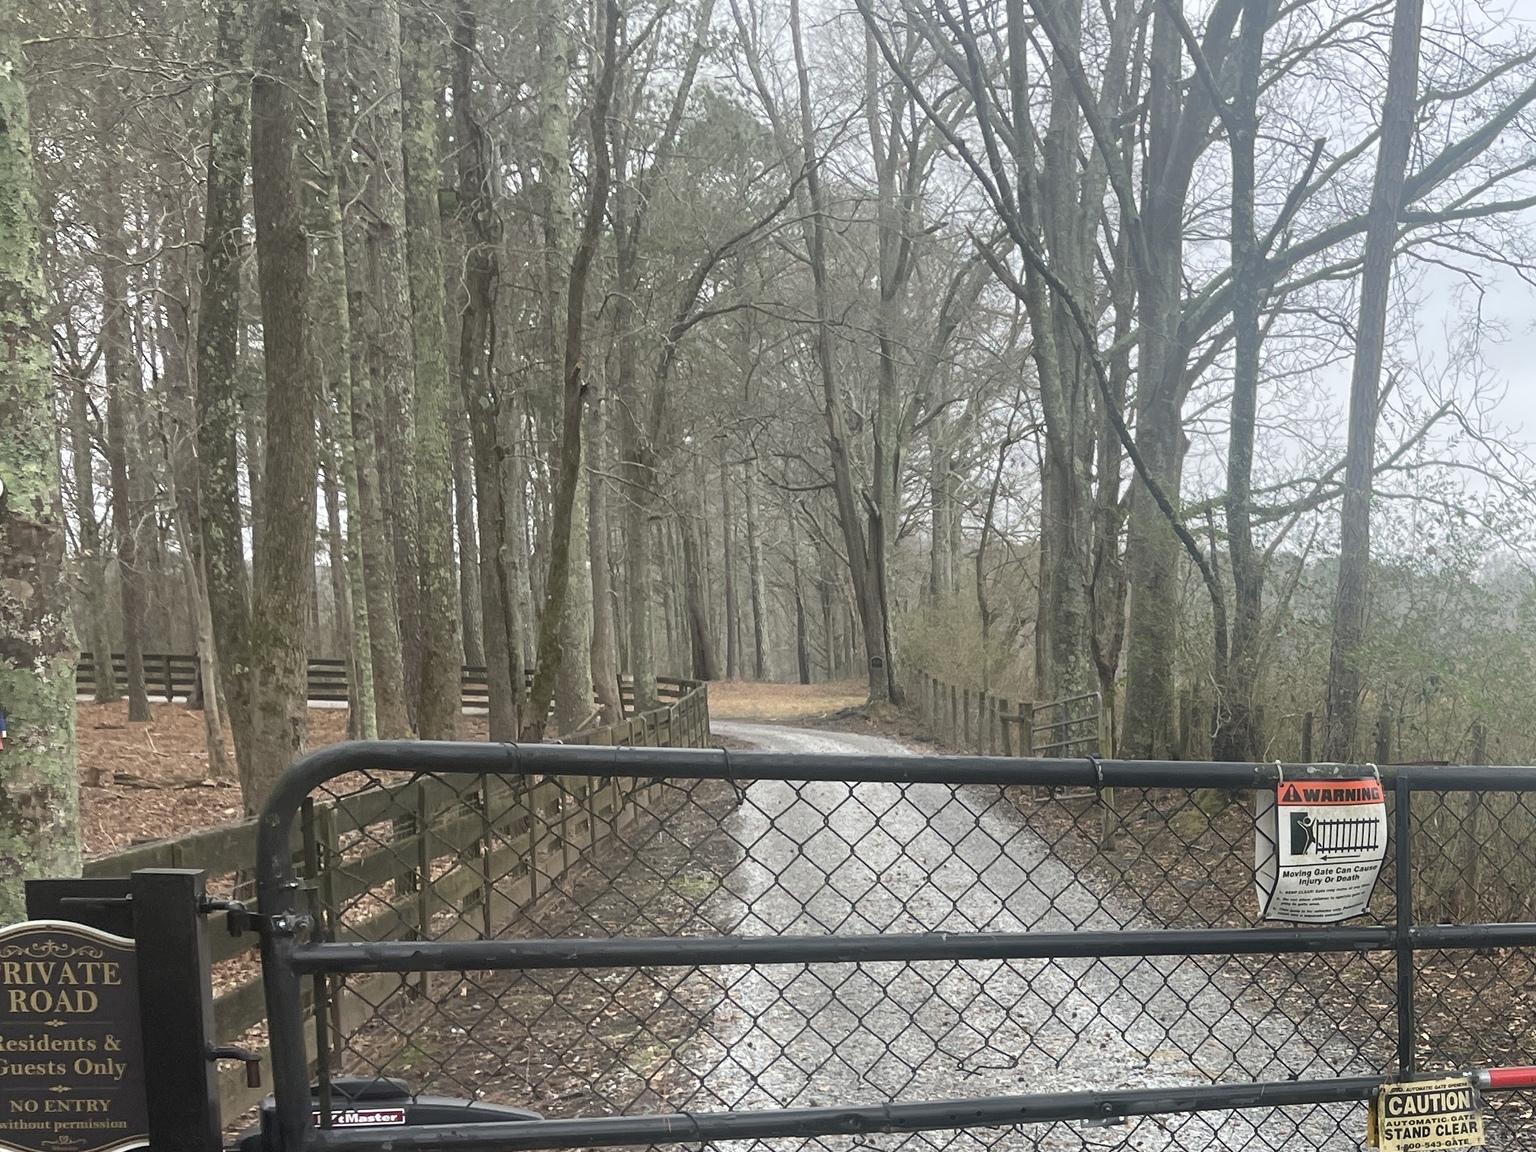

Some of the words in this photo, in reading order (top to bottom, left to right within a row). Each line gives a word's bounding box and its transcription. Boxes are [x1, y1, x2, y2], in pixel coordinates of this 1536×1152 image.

[1302, 787, 1380, 802] WARNING
[1282, 869, 1312, 879] Moving
[1314, 868, 1333, 876] Gate
[1354, 864, 1378, 873] Cause
[1299, 876, 1322, 886] Injury
[1336, 874, 1360, 882] Death
[0, 961, 121, 985] RIVATE
[8, 989, 98, 1013] ROAD
[104, 1034, 121, 1051] &
[74, 1058, 127, 1081] Only
[10, 1099, 39, 1113] NO
[44, 1099, 111, 1113] ENTRY
[1388, 1090, 1470, 1115] CAUTION
[0, 1119, 51, 1129] without
[54, 1118, 127, 1132] permission
[1386, 1117, 1448, 1127] AUTOMATIC
[1451, 1114, 1475, 1122] GATE
[1385, 1125, 1430, 1140] STAND
[1436, 1121, 1478, 1137] CLEAR
